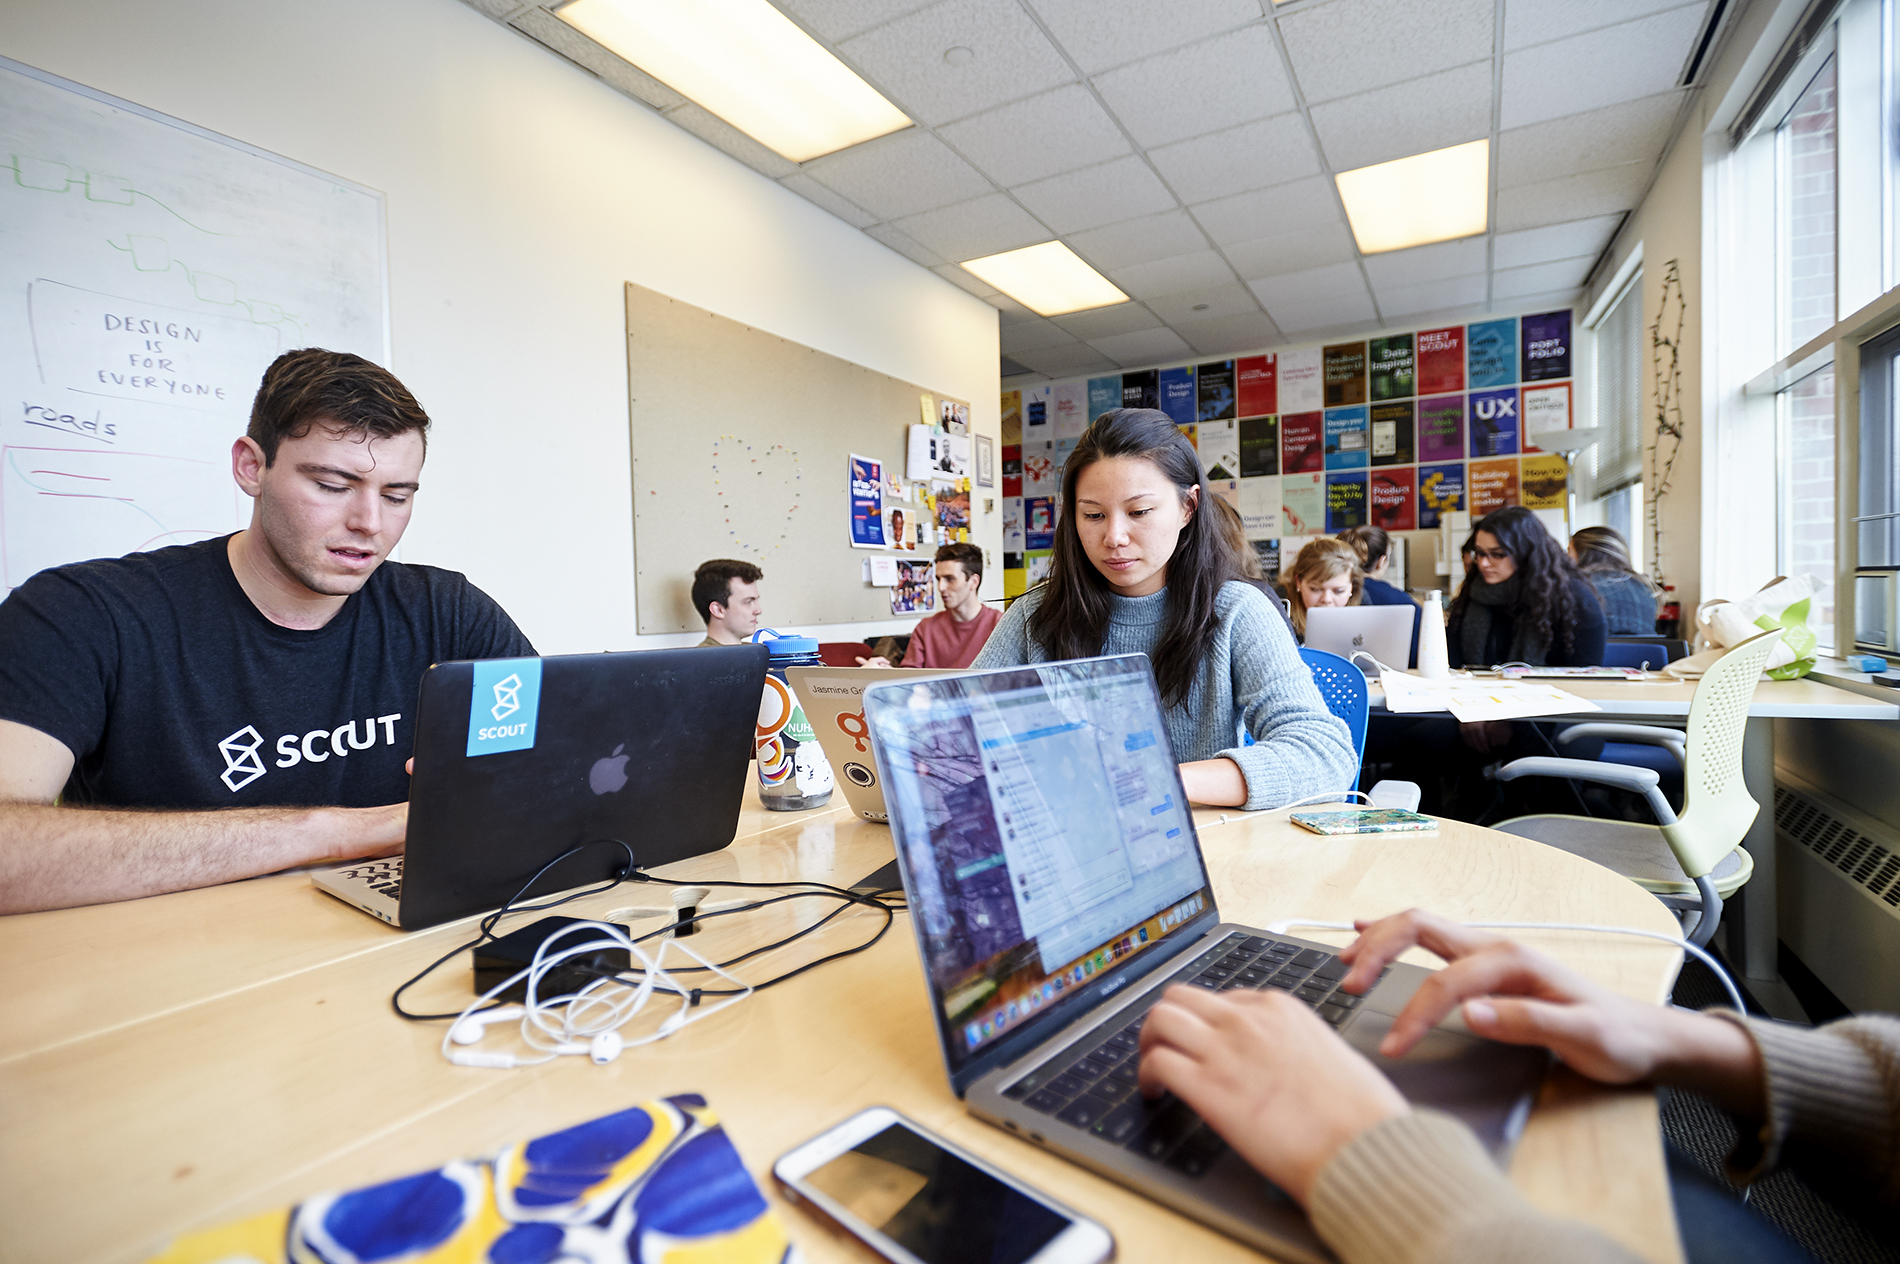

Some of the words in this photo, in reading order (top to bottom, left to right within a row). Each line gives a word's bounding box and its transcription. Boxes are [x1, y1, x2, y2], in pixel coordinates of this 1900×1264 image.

[104, 313, 201, 343] DESIGN
[1420, 331, 1450, 343] MEET
[145, 340, 163, 353] IS
[1420, 339, 1459, 353] SCOUT
[1528, 338, 1562, 350] PORT
[1528, 347, 1566, 360] FOLIO
[129, 354, 176, 372] FOR
[1326, 363, 1352, 372] Driven
[1371, 356, 1413, 371] Inspired
[1326, 372, 1354, 381] Design
[98, 370, 225, 400] EVERYONE
[1168, 382, 1193, 390] Product
[1168, 389, 1190, 398] Design
[1475, 397, 1517, 421] UX
[21, 401, 117, 436] roads
[1432, 419, 1454, 427] Web
[1284, 427, 1310, 435] Human
[1284, 433, 1316, 443] Centered
[1472, 471, 1509, 480] Building
[1328, 484, 1351, 493] Design
[1352, 483, 1361, 491] by
[1472, 480, 1504, 488] brands
[1374, 485, 1410, 495] Product
[1472, 490, 1491, 498] that
[1374, 494, 1405, 505] Design
[1473, 498, 1505, 506] matter
[1328, 500, 1347, 510] Night
[812, 685, 849, 695] Jasmine
[478, 723, 528, 741] SCOUT
[788, 723, 813, 733] NUH
[275, 713, 402, 769] SCOUT
